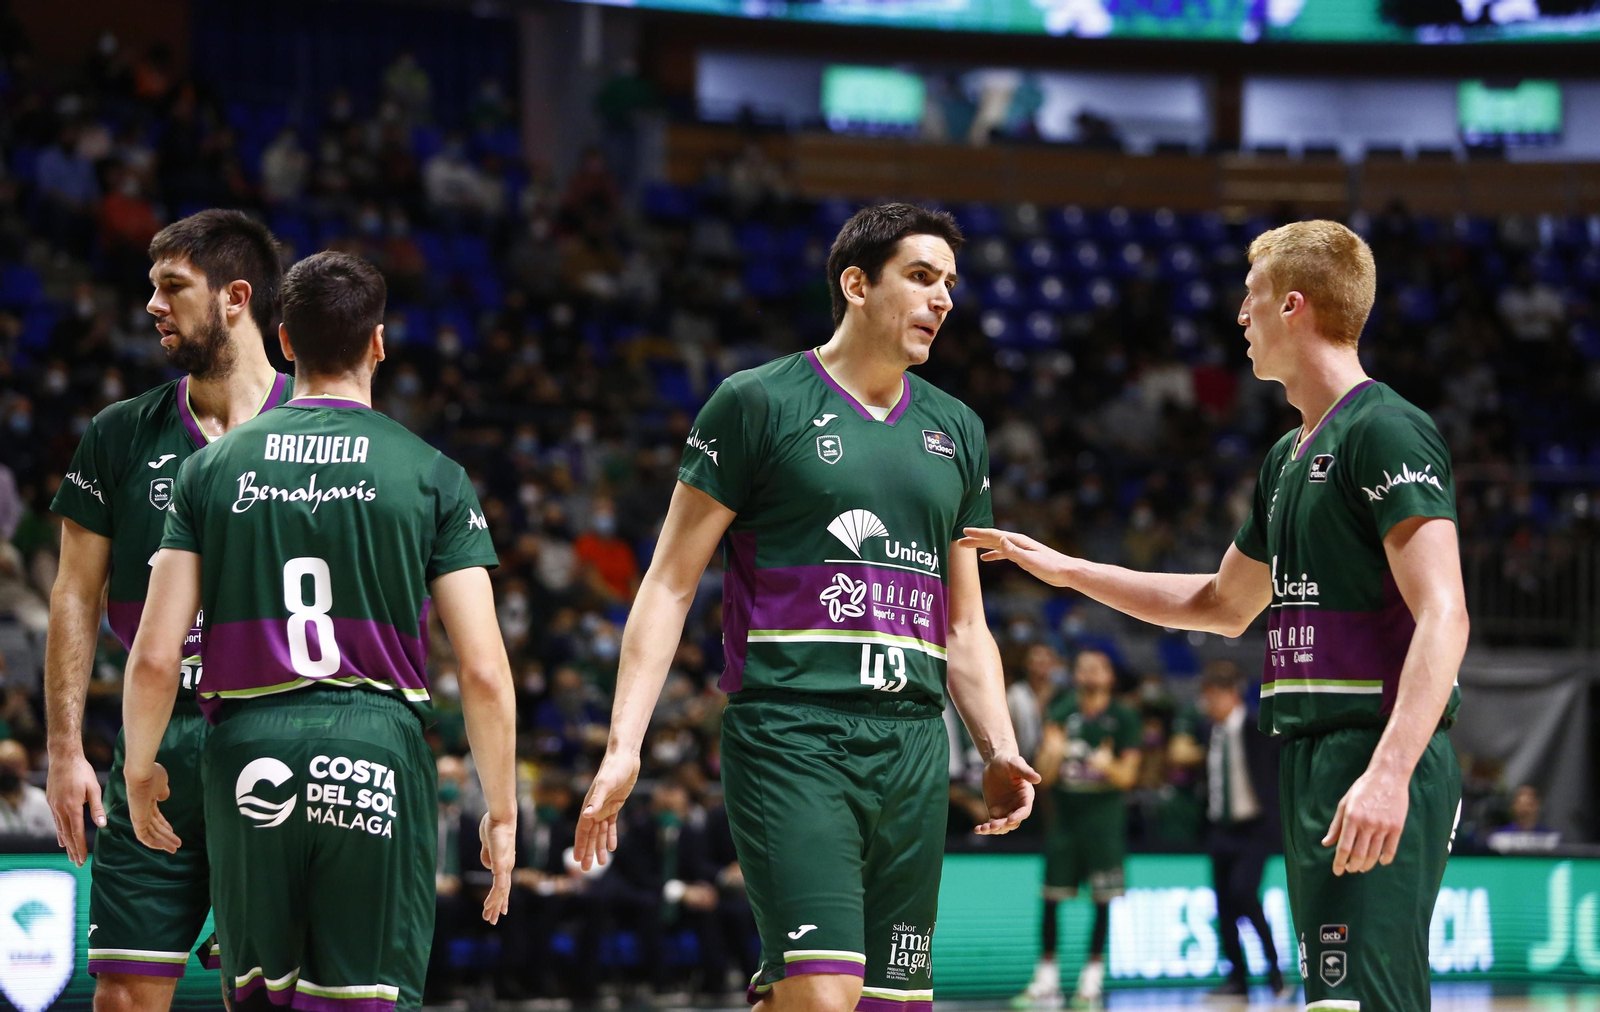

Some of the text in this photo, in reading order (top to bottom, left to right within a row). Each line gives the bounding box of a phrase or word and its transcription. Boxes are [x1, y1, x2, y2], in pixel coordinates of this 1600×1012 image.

[264, 433, 370, 464] BRIZUELA
[1361, 462, 1443, 502] Andalucía
[872, 580, 934, 612] MÁLAGA
[283, 557, 341, 679] 8
[900, 613, 906, 625] y
[860, 643, 908, 693] 43
[309, 755, 396, 796] COSTA
[306, 783, 397, 818] DEL SOL
[306, 804, 392, 839] MÁLAGA
[891, 931, 899, 941] a
[892, 921, 917, 932] sabor
[1322, 931, 1341, 940] acb
